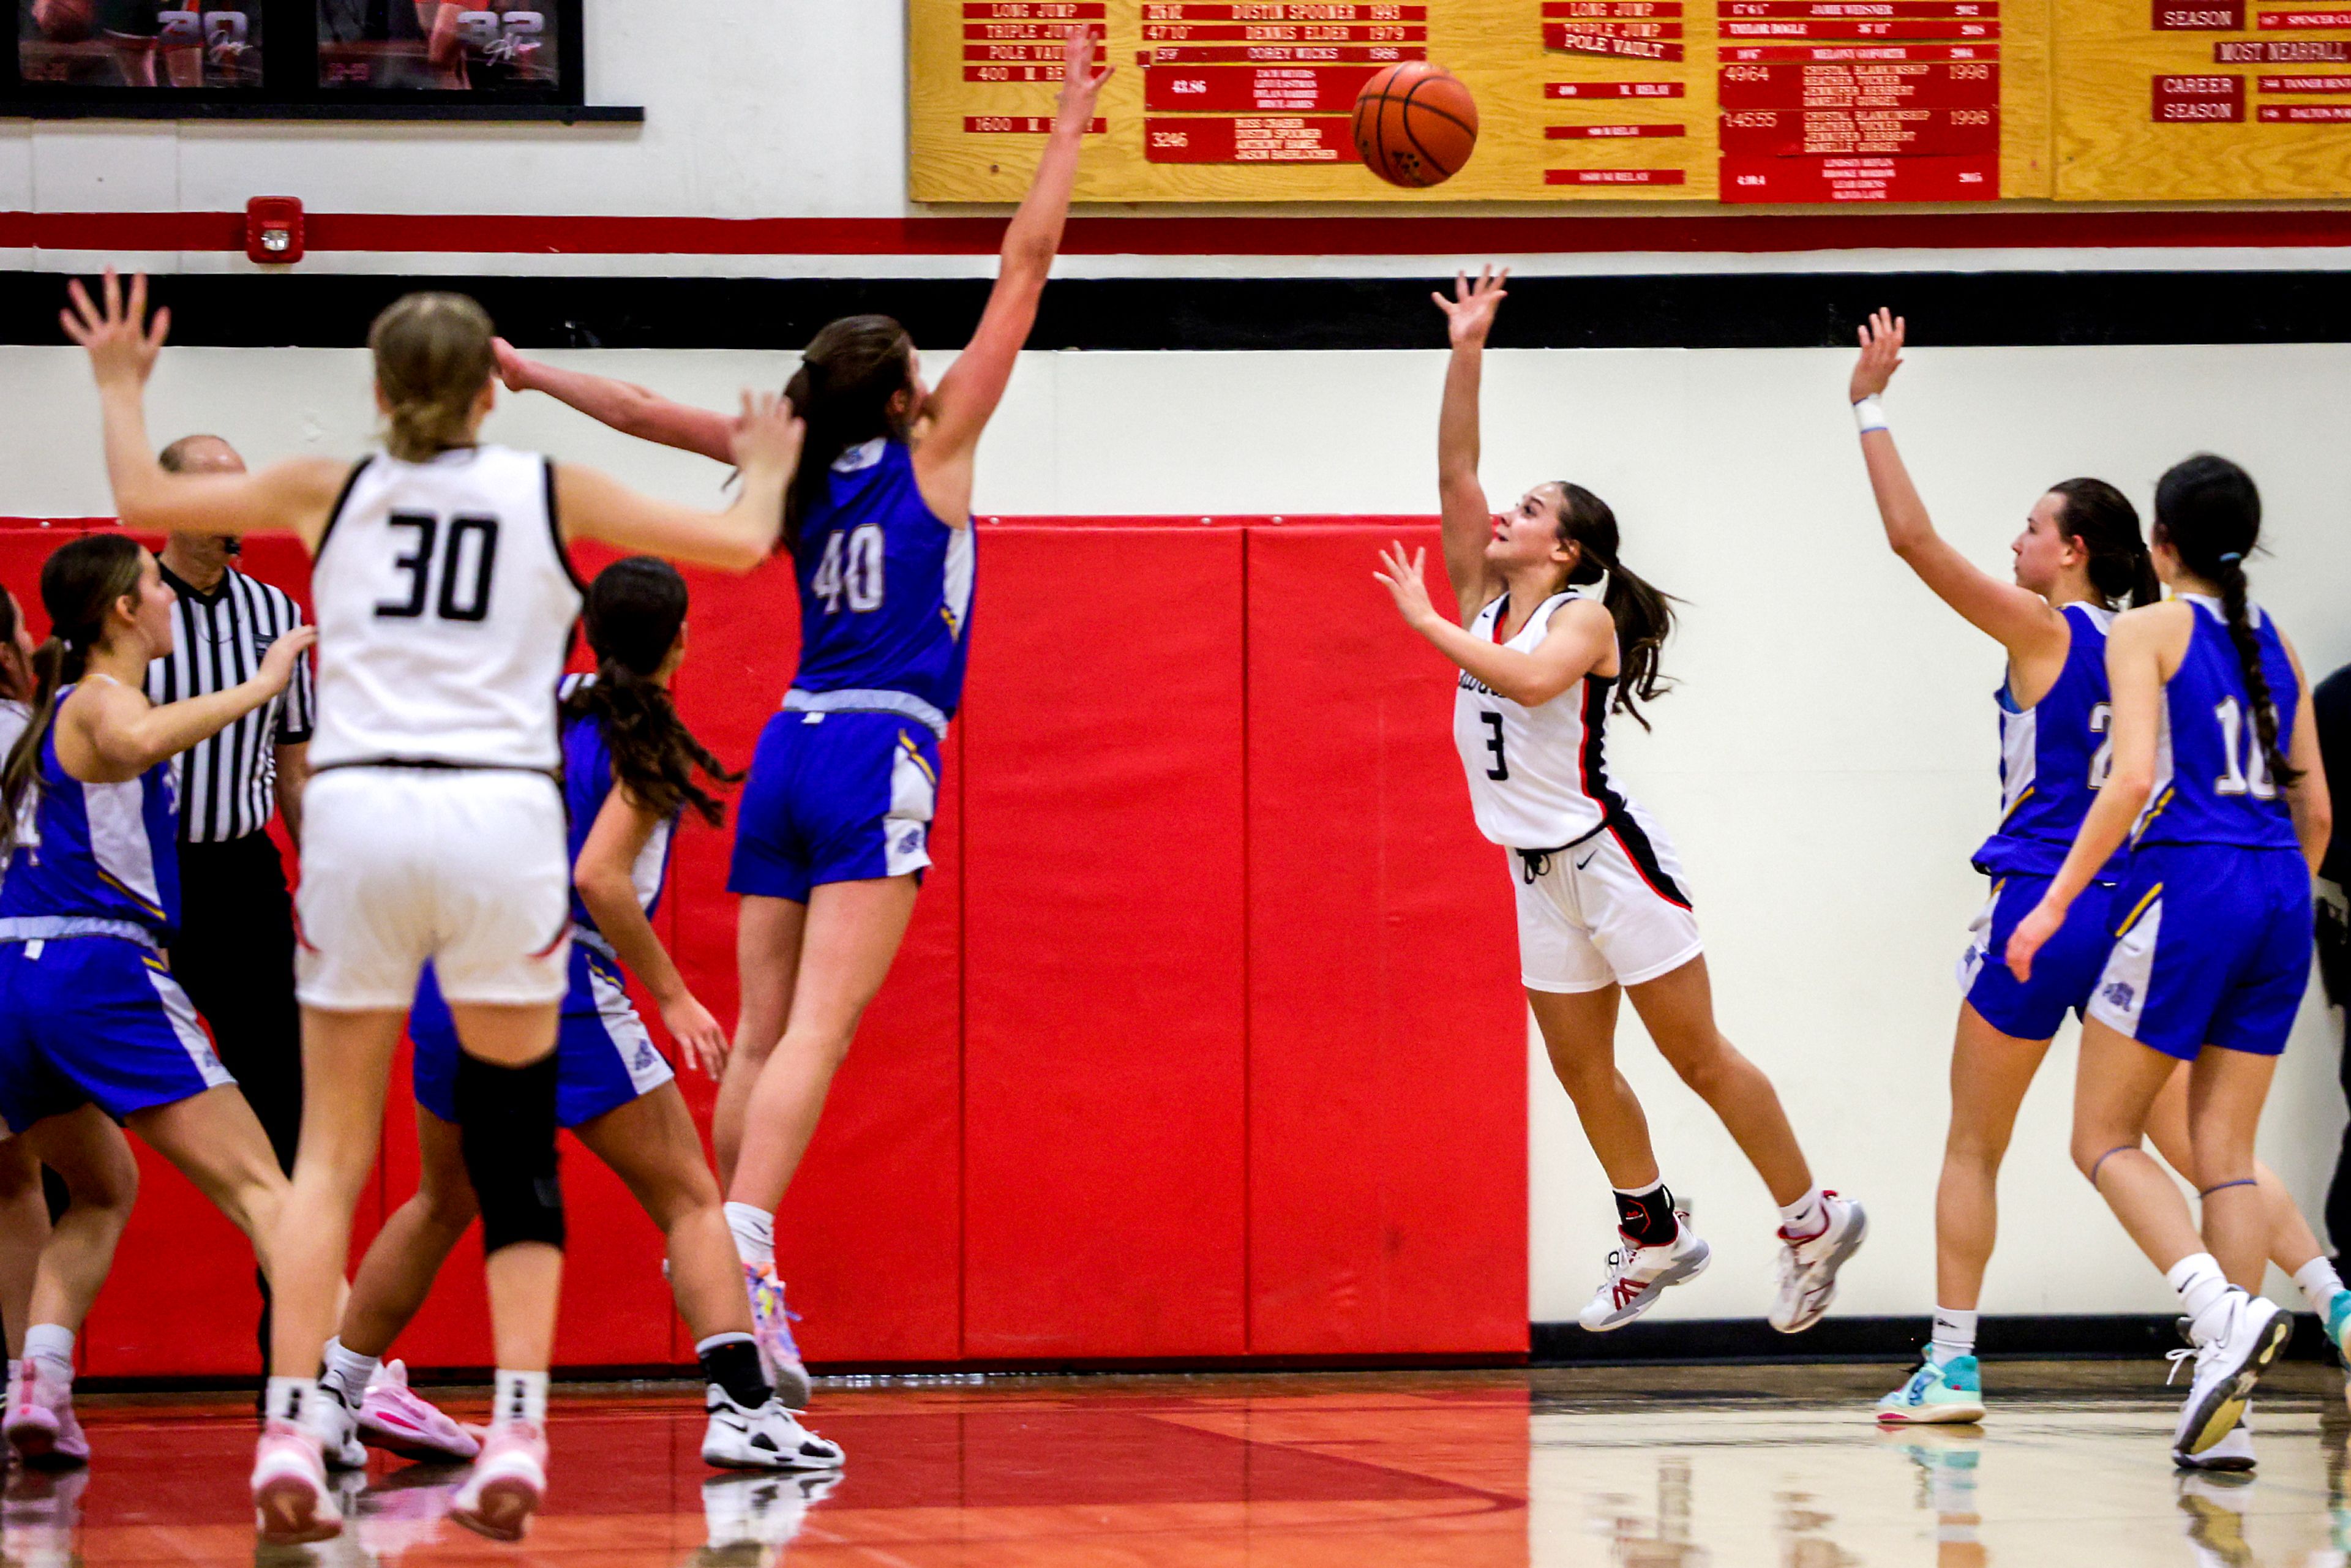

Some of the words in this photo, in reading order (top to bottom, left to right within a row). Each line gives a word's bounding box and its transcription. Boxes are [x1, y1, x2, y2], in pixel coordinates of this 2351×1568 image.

[992, 4, 1029, 17] LONG
[1037, 4, 1076, 17] JUMP
[1233, 6, 1283, 19] DUSTIN
[1289, 6, 1355, 19] SPOONER
[1571, 3, 1607, 16] LONG
[1614, 3, 1653, 16] JUMP
[2165, 12, 2231, 25] SEASON
[457, 12, 544, 45] 32
[986, 25, 1036, 38] TRIPLE
[1247, 27, 1295, 39] DENNIS
[1305, 27, 1348, 39] ELDER
[1370, 27, 1404, 39] 1979
[1564, 23, 1614, 36] TRIPLE
[1622, 24, 1660, 37] JUMP
[990, 46, 1026, 59] POLE
[1564, 34, 1608, 51] POLE
[1613, 39, 1664, 58] VAULT
[2221, 42, 2262, 60] MOST
[1250, 48, 1291, 59] COREY
[1295, 48, 1337, 59] WICKS
[978, 67, 1008, 80] 400
[2163, 78, 2233, 93] CAREER
[2164, 103, 2231, 118] SEASON
[976, 118, 1011, 130] 1600
[375, 512, 498, 622] 30
[811, 523, 885, 615] 40
[1481, 711, 1508, 781] 3
